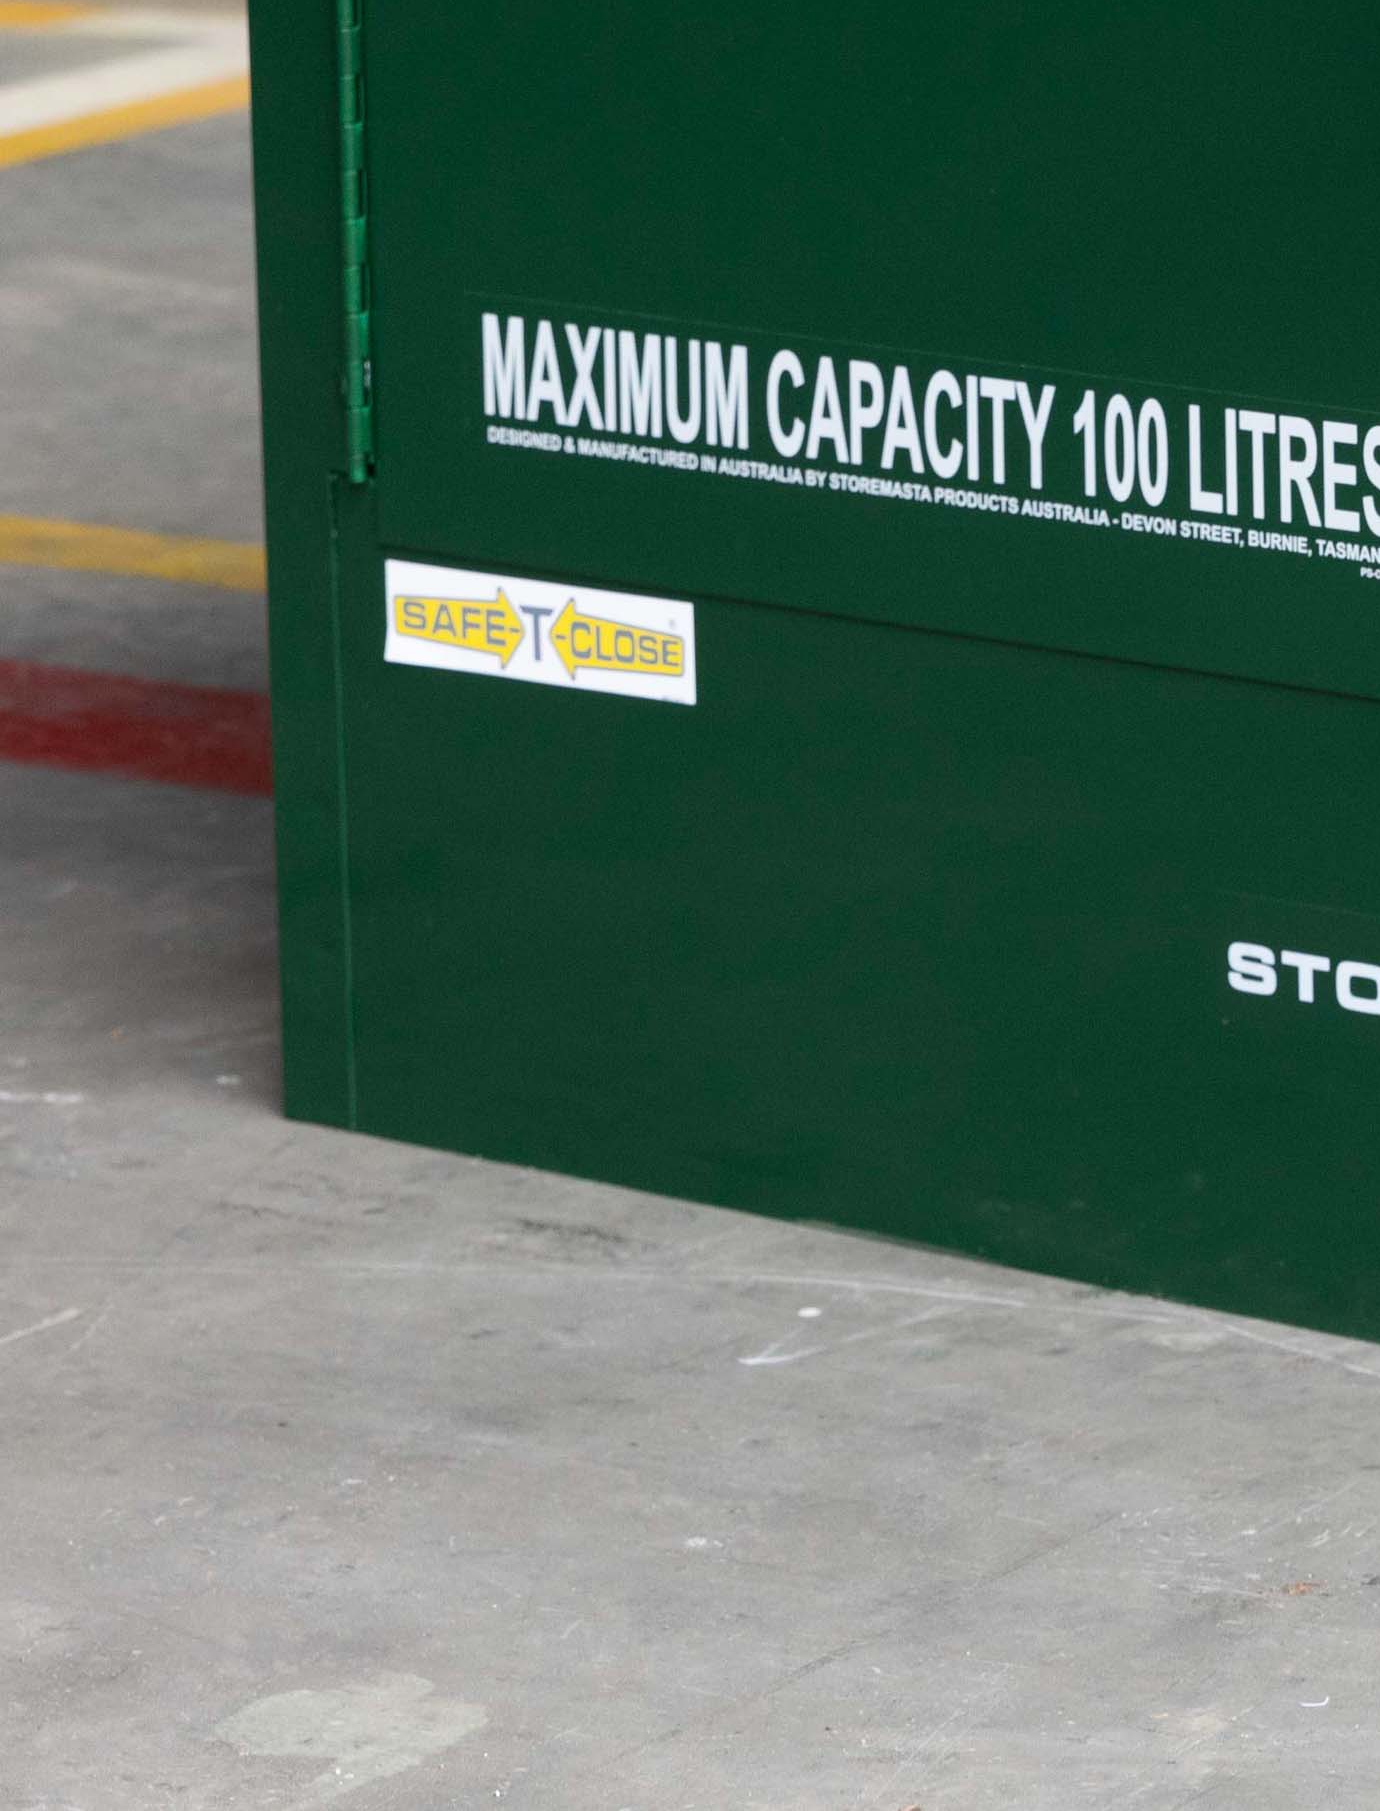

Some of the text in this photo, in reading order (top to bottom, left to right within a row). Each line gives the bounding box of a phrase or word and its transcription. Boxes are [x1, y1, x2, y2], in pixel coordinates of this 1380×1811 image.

[480, 311, 750, 451] MAXIMUM
[765, 348, 1057, 491] CAPACITY
[1071, 388, 1170, 508] 100
[486, 425, 562, 453] DESIGNED
[562, 438, 576, 453] &
[577, 439, 699, 471] MANUFACTURED
[700, 455, 718, 474] IN
[718, 457, 804, 486] AUSTRALIA
[804, 470, 827, 489] BY
[829, 472, 932, 503] STOREMASTA
[933, 486, 1019, 515] PRODUCTS
[1021, 499, 1109, 527] AUSTRALIA
[1121, 515, 1177, 536] DEVON
[1179, 521, 1246, 548] STREET,
[1247, 529, 1313, 558] BURNIE,
